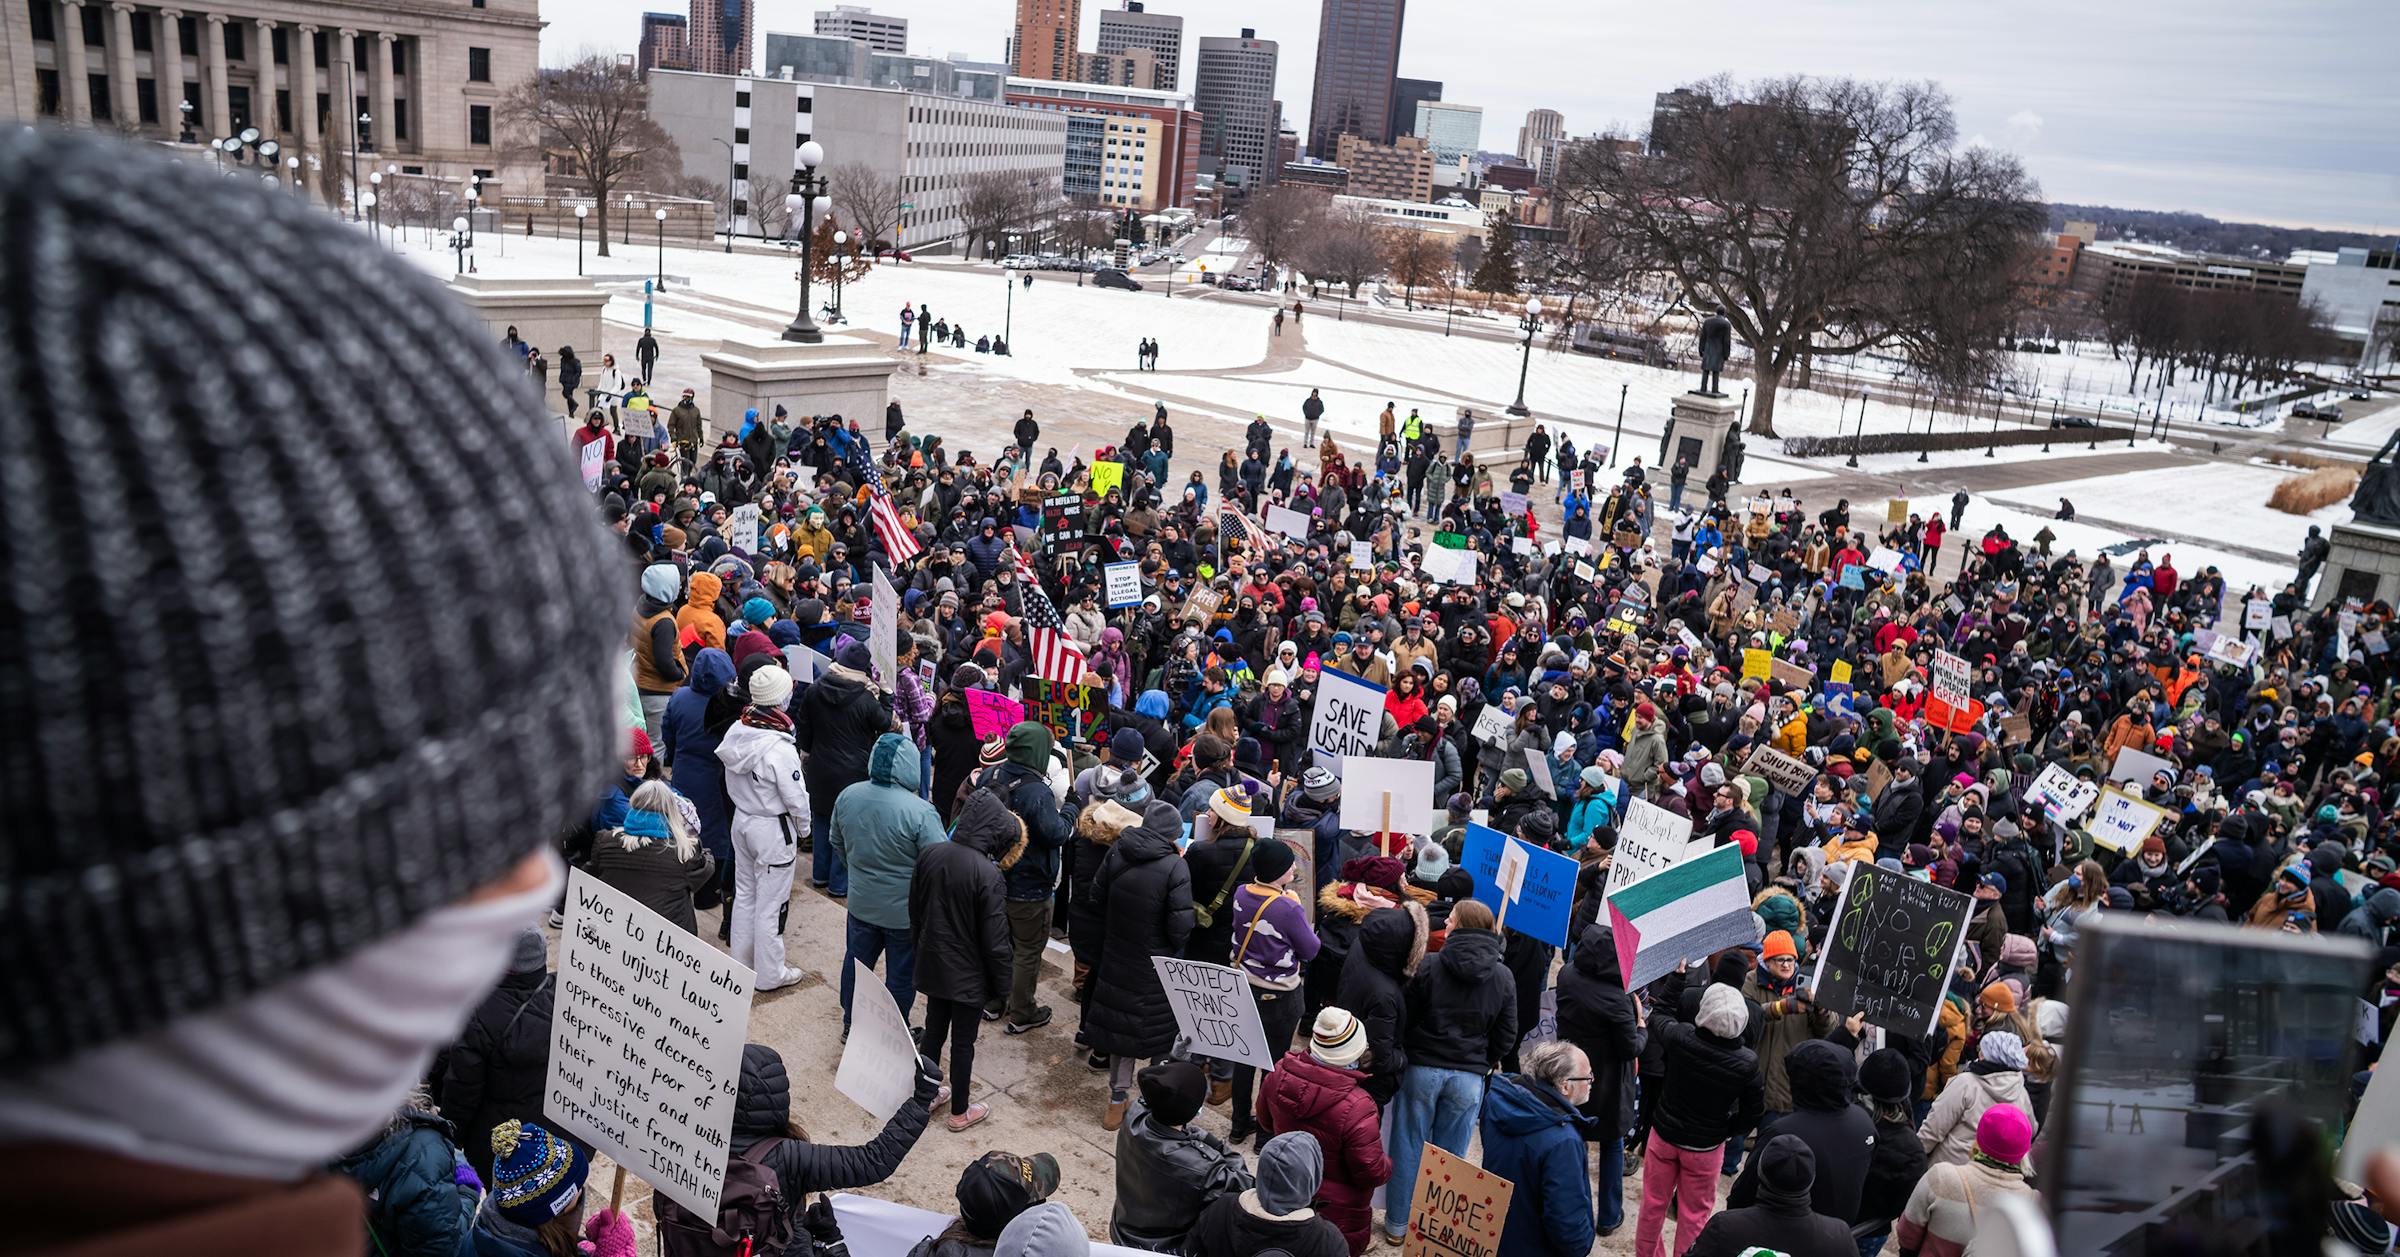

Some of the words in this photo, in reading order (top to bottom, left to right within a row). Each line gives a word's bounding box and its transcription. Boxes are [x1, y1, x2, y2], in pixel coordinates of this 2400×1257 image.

[1093, 465, 1112, 481] NO
[1044, 498, 1055, 507] WE
[1055, 495, 1080, 506] DEFEATED
[1064, 505, 1080, 516] ONCE
[1046, 533, 1055, 543] WE
[1059, 530, 1071, 540] CAN
[1074, 529, 1083, 539] DO
[1047, 545, 1055, 555] IT
[1109, 594, 1141, 603] ACTIONS!
[1111, 588, 1137, 596] ILLEGAL
[1934, 665, 1952, 681] NEVER
[1952, 673, 1969, 688] MADE
[1936, 651, 1965, 674] HATE
[982, 692, 1008, 708] EAT
[1039, 679, 1091, 711] FUCK
[1935, 686, 1964, 708] GREAT
[1939, 678, 1968, 697] AMERICA
[1020, 698, 1067, 727] THE
[1070, 707, 1109, 744] 1%
[1325, 698, 1371, 736] SAVE
[1315, 721, 1368, 757] USAID
[1476, 713, 1508, 741] RESI
[1760, 751, 1792, 772] SHUT
[1790, 765, 1814, 781] DOWN
[1771, 771, 1802, 792] SENATE
[2075, 782, 2090, 795] NO
[2040, 782, 2076, 810] WITHOUT
[2116, 798, 2131, 810] MY
[2105, 816, 2117, 825] IS
[2117, 819, 2137, 833] NOT
[1620, 837, 1672, 869] REJECT
[1529, 865, 1539, 879] IS
[1541, 871, 1549, 884] A
[1613, 862, 1636, 887] PRO
[1521, 880, 1562, 903] RESIDENT"
[1863, 900, 1911, 933] NO
[579, 886, 614, 923] Woe
[625, 913, 645, 942] to
[656, 930, 702, 974] those
[710, 969, 743, 996] who
[576, 917, 612, 955] issue
[622, 949, 670, 990] unjust
[681, 981, 724, 1024] laws,
[1164, 960, 1241, 997] PROTECT
[570, 949, 585, 972] to
[590, 962, 626, 996] those
[632, 993, 663, 1018] who
[669, 1015, 711, 1051] make
[1174, 988, 1239, 1018] TRANS
[565, 980, 646, 1040] oppressive
[654, 1035, 718, 1091] decrees,
[723, 1079, 737, 1097] to
[1190, 1013, 1250, 1057] KIDS
[562, 1006, 614, 1048] deprive
[623, 1043, 648, 1070] the
[651, 1067, 686, 1093] poor
[694, 1095, 714, 1111] of
[559, 1034, 596, 1068] their
[606, 1068, 650, 1103] rights
[658, 1101, 689, 1128] and
[695, 1122, 729, 1149] with-
[558, 1060, 583, 1092] hold
[589, 1086, 640, 1130] justice
[646, 1117, 684, 1157] from
[694, 1152, 722, 1182] the
[552, 1089, 630, 1150] oppressed.
[639, 1147, 699, 1197] -ISAIAH
[701, 1183, 719, 1208] 10:1
[1425, 1180, 1485, 1232] MORE
[1418, 1212, 1493, 1257] LEARNING
